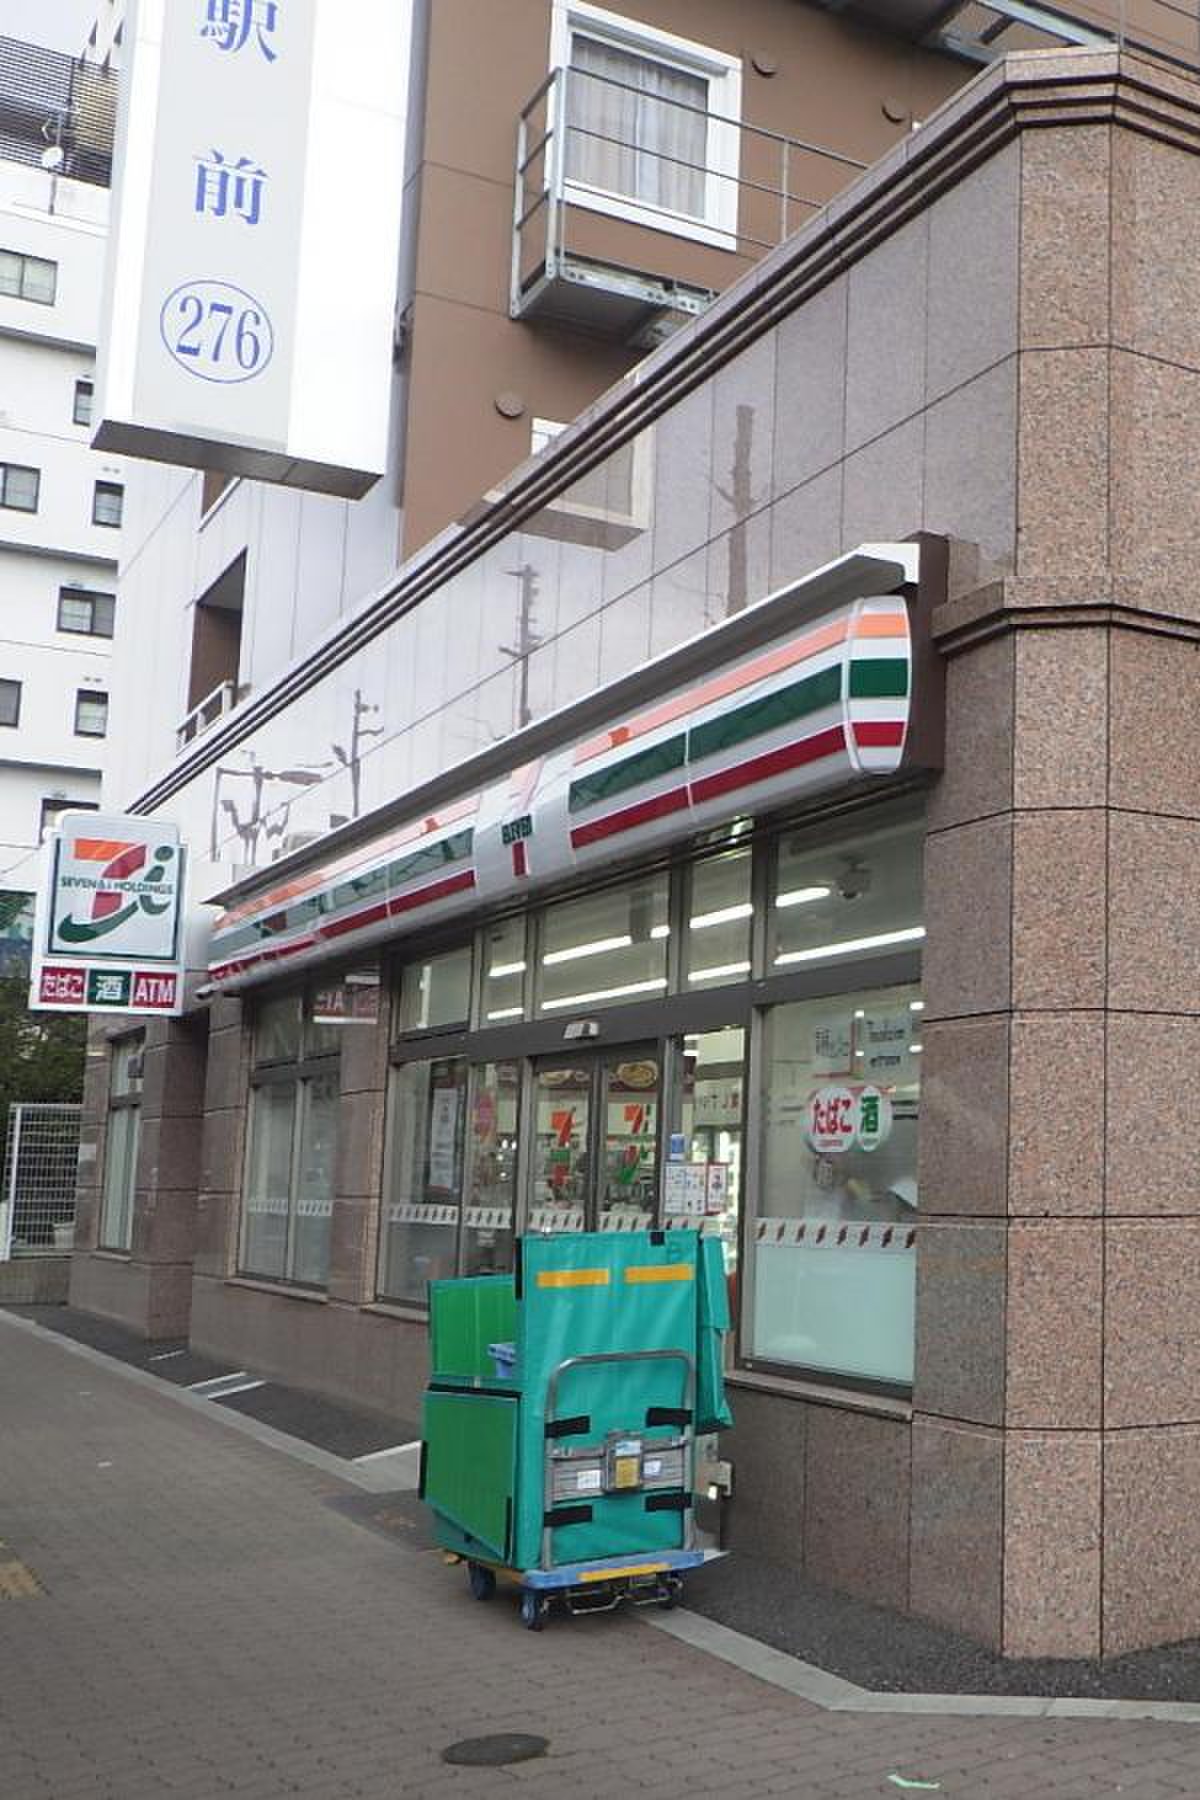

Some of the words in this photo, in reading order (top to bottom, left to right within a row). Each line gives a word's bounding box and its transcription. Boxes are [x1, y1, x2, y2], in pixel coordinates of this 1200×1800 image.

[176, 295, 261, 369] 276
[136, 977, 175, 1003] ATM
[813, 1097, 853, 1135] たばこ
[859, 1096, 880, 1133] 酒
